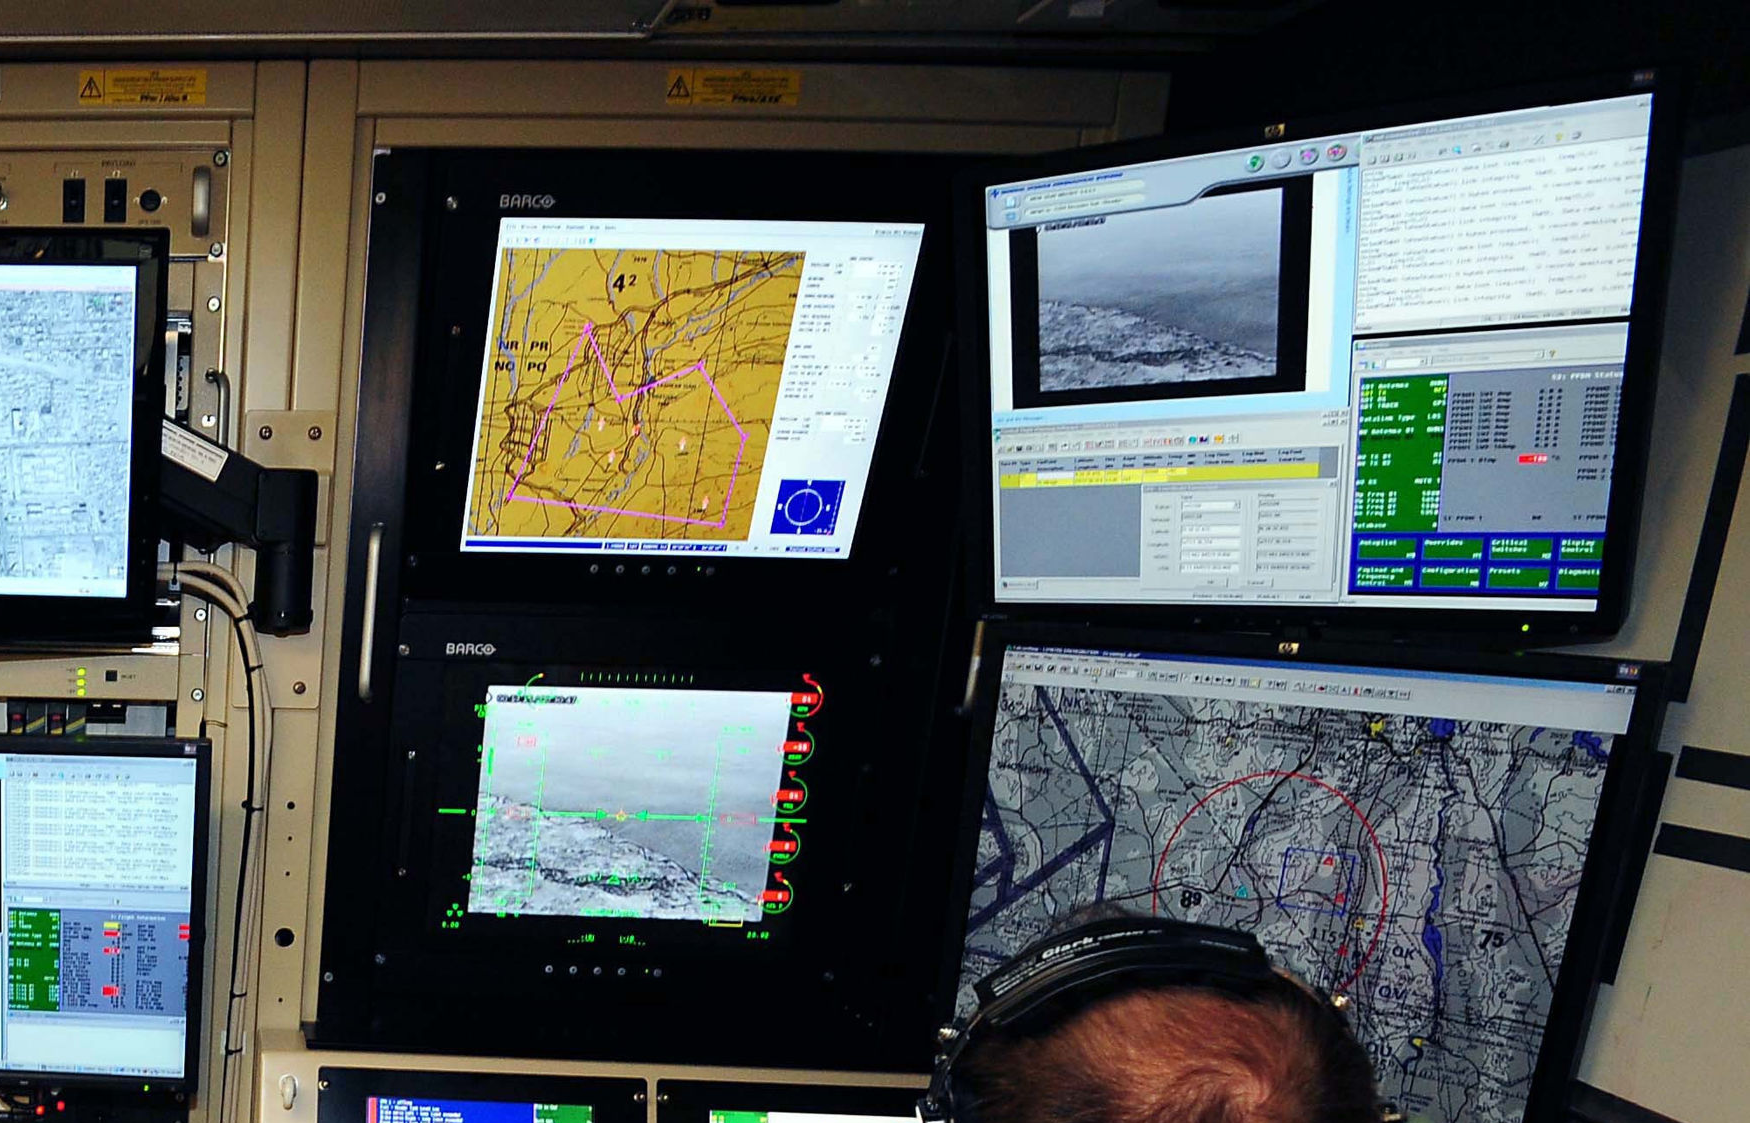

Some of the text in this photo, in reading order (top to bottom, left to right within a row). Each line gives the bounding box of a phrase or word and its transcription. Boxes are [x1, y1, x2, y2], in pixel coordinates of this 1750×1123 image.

[500, 194, 556, 208] BARCO
[445, 643, 497, 656] BARCO
[1041, 936, 1095, 960] Clark
[1478, 930, 1505, 950] 75
